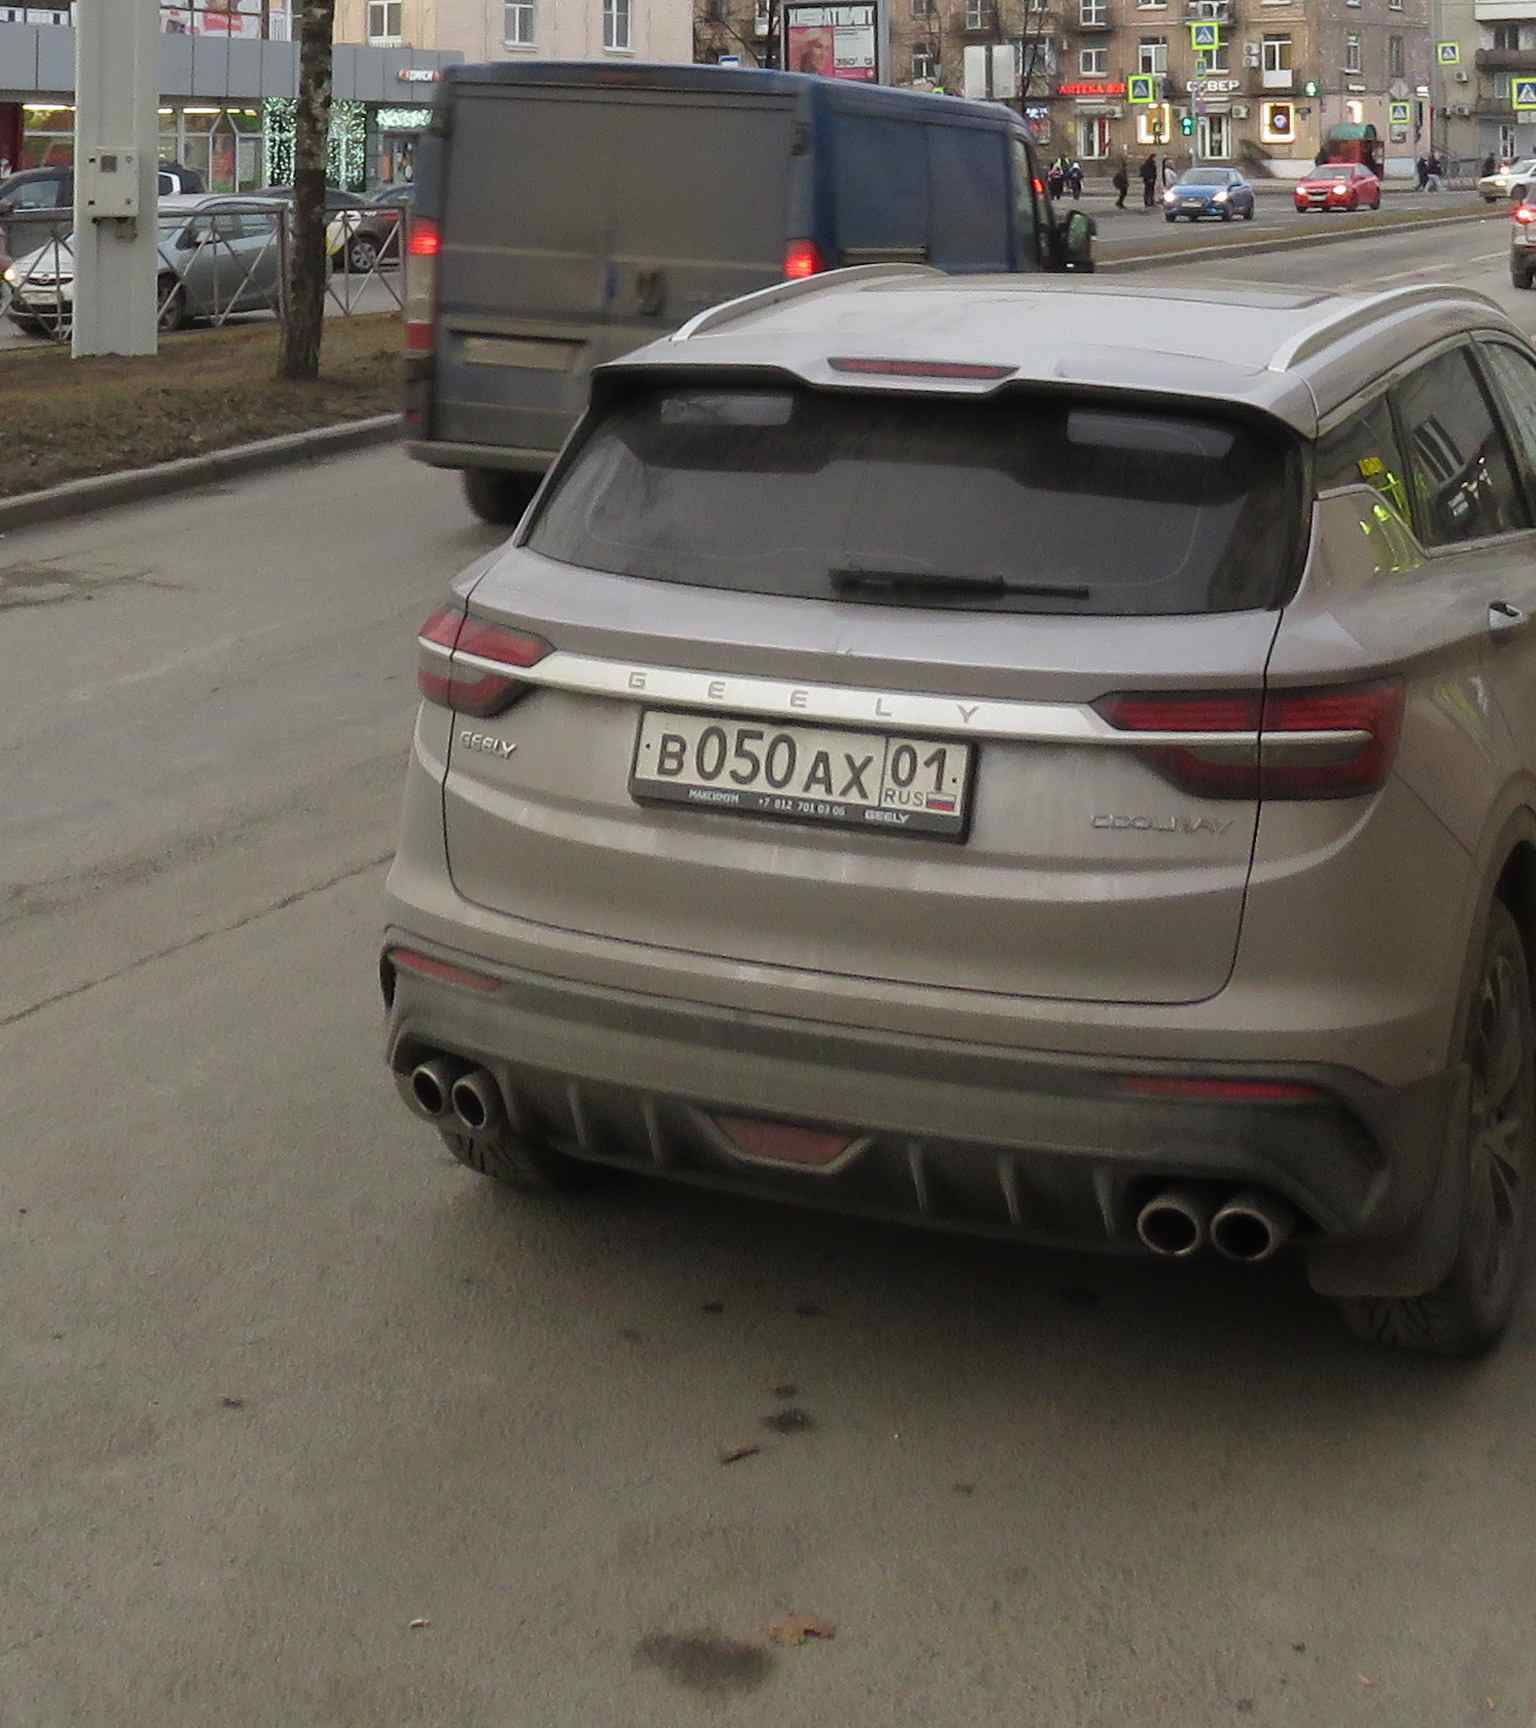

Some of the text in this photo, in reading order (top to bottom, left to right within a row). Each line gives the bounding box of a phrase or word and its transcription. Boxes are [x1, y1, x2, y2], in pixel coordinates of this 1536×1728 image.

[628, 671, 979, 724] GEELY
[657, 725, 948, 801] В050АХ 01
[758, 796, 770, 808] +7
[774, 798, 793, 810] 812
[797, 800, 816, 813] 701
[883, 787, 925, 808] RUS
[864, 808, 911, 824] GEELY
